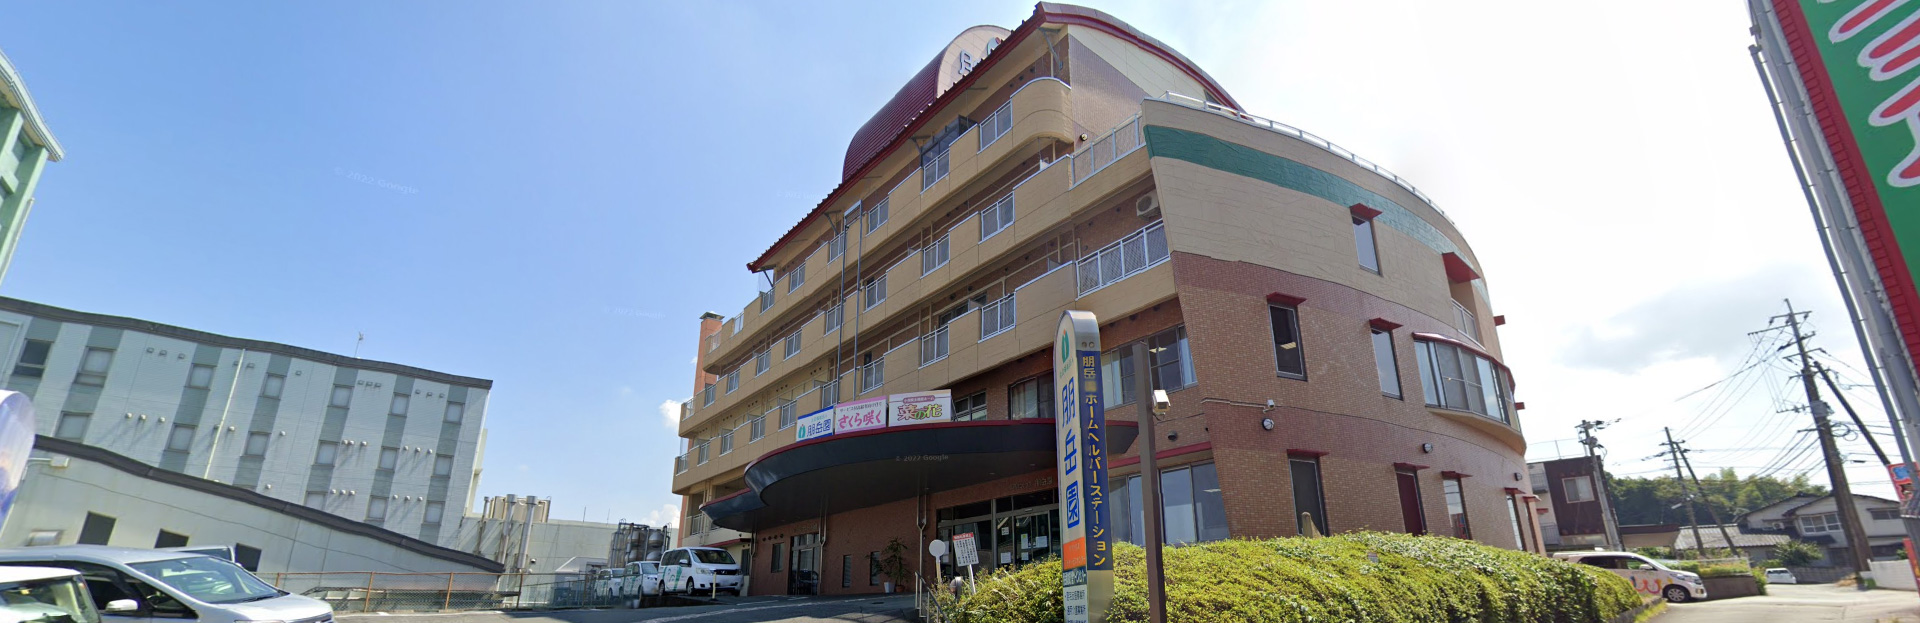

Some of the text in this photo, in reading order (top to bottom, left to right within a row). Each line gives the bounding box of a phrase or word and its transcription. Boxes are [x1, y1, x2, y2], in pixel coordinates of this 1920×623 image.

[838, 410, 881, 429] さくら咲く
[897, 404, 942, 421] 菜の花
[806, 419, 830, 437] 朋岳園
[1062, 376, 1081, 529] 朋岳園
[1083, 356, 1106, 566] 朋岳ホームヘルパーステーション
